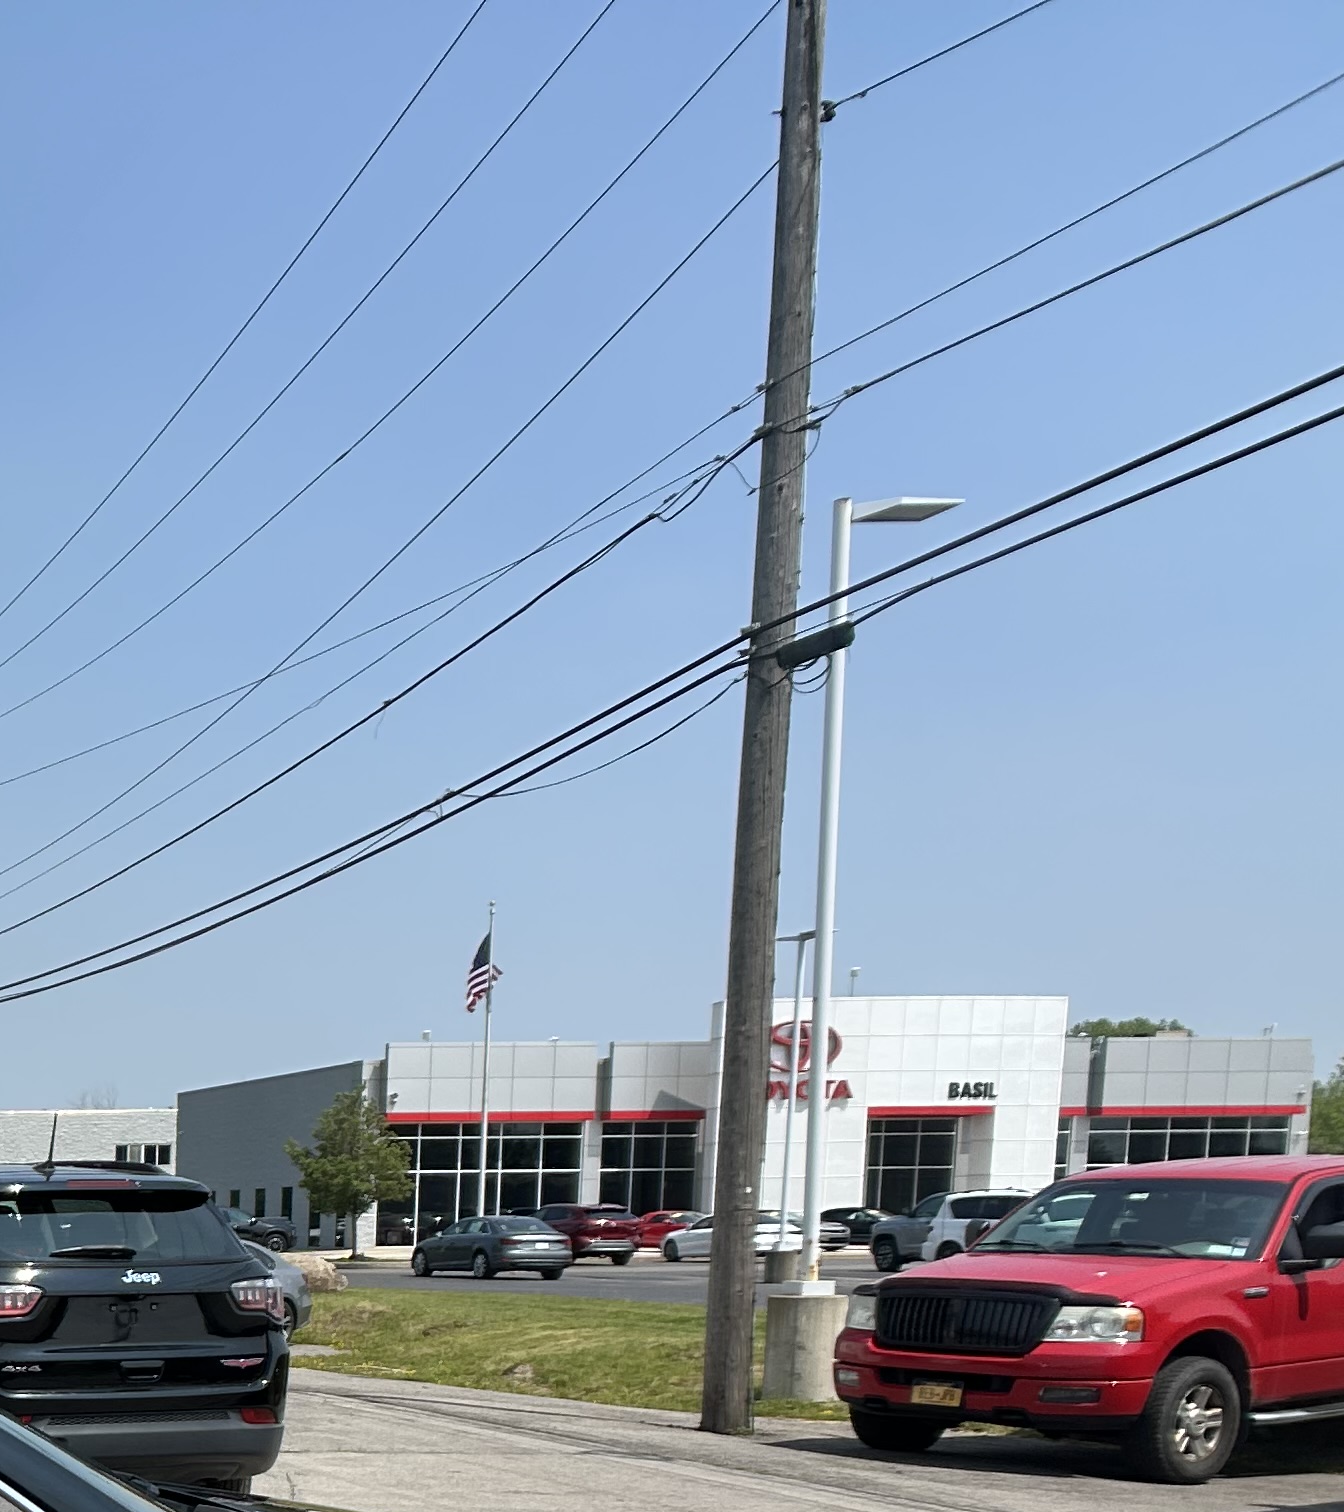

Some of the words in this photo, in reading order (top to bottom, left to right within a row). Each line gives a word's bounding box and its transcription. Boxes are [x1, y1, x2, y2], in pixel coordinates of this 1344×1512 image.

[768, 1079, 854, 1099] YOTA
[947, 1081, 999, 1099] BASIL
[120, 1268, 162, 1285] Jeep
